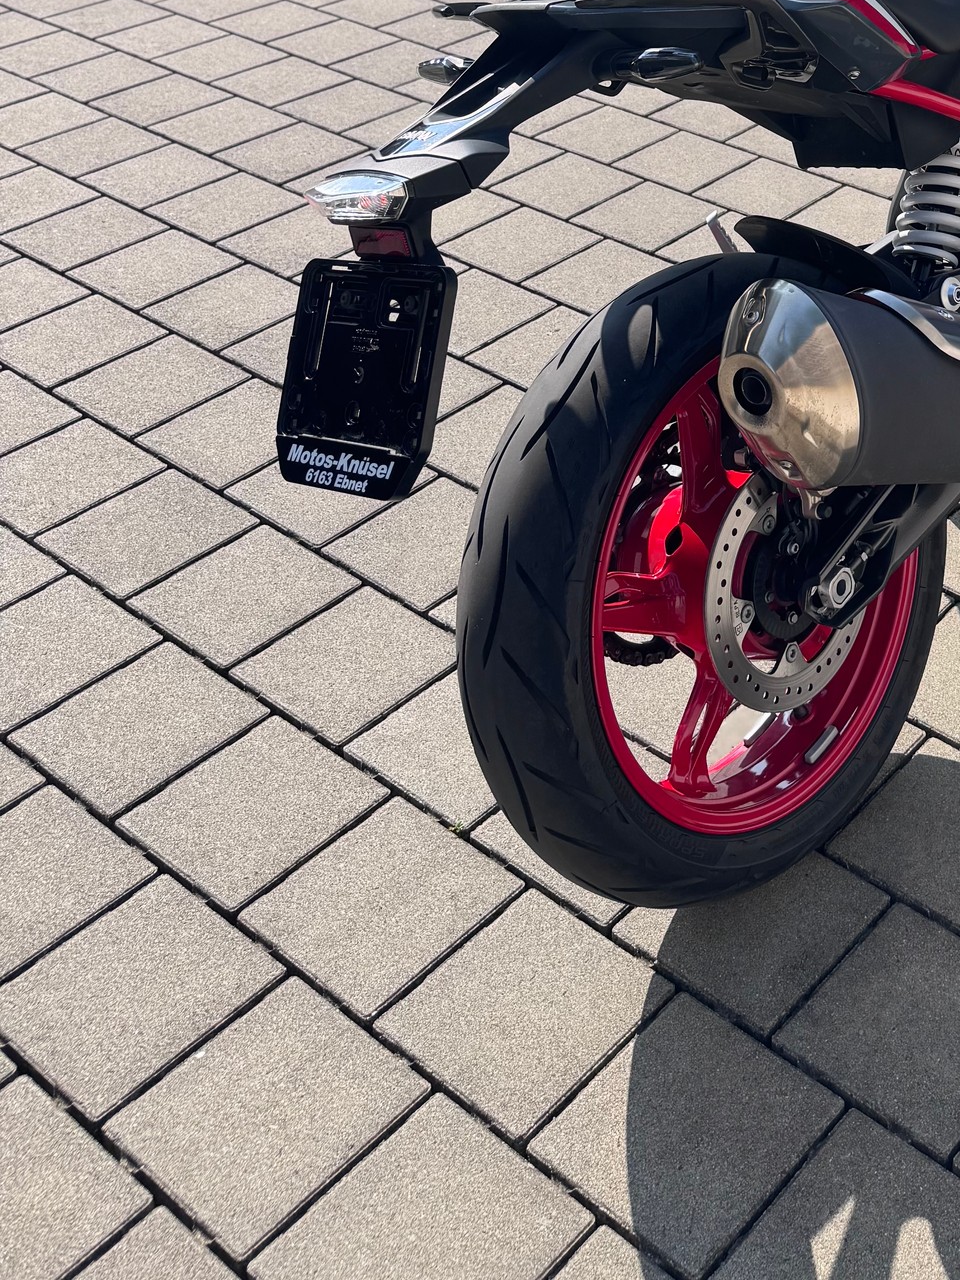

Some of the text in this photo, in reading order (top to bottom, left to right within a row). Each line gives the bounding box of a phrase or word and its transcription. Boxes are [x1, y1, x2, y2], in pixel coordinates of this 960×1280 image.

[286, 443, 396, 480] Motos-Knüsel
[305, 468, 369, 493] 6163 Ebnet
